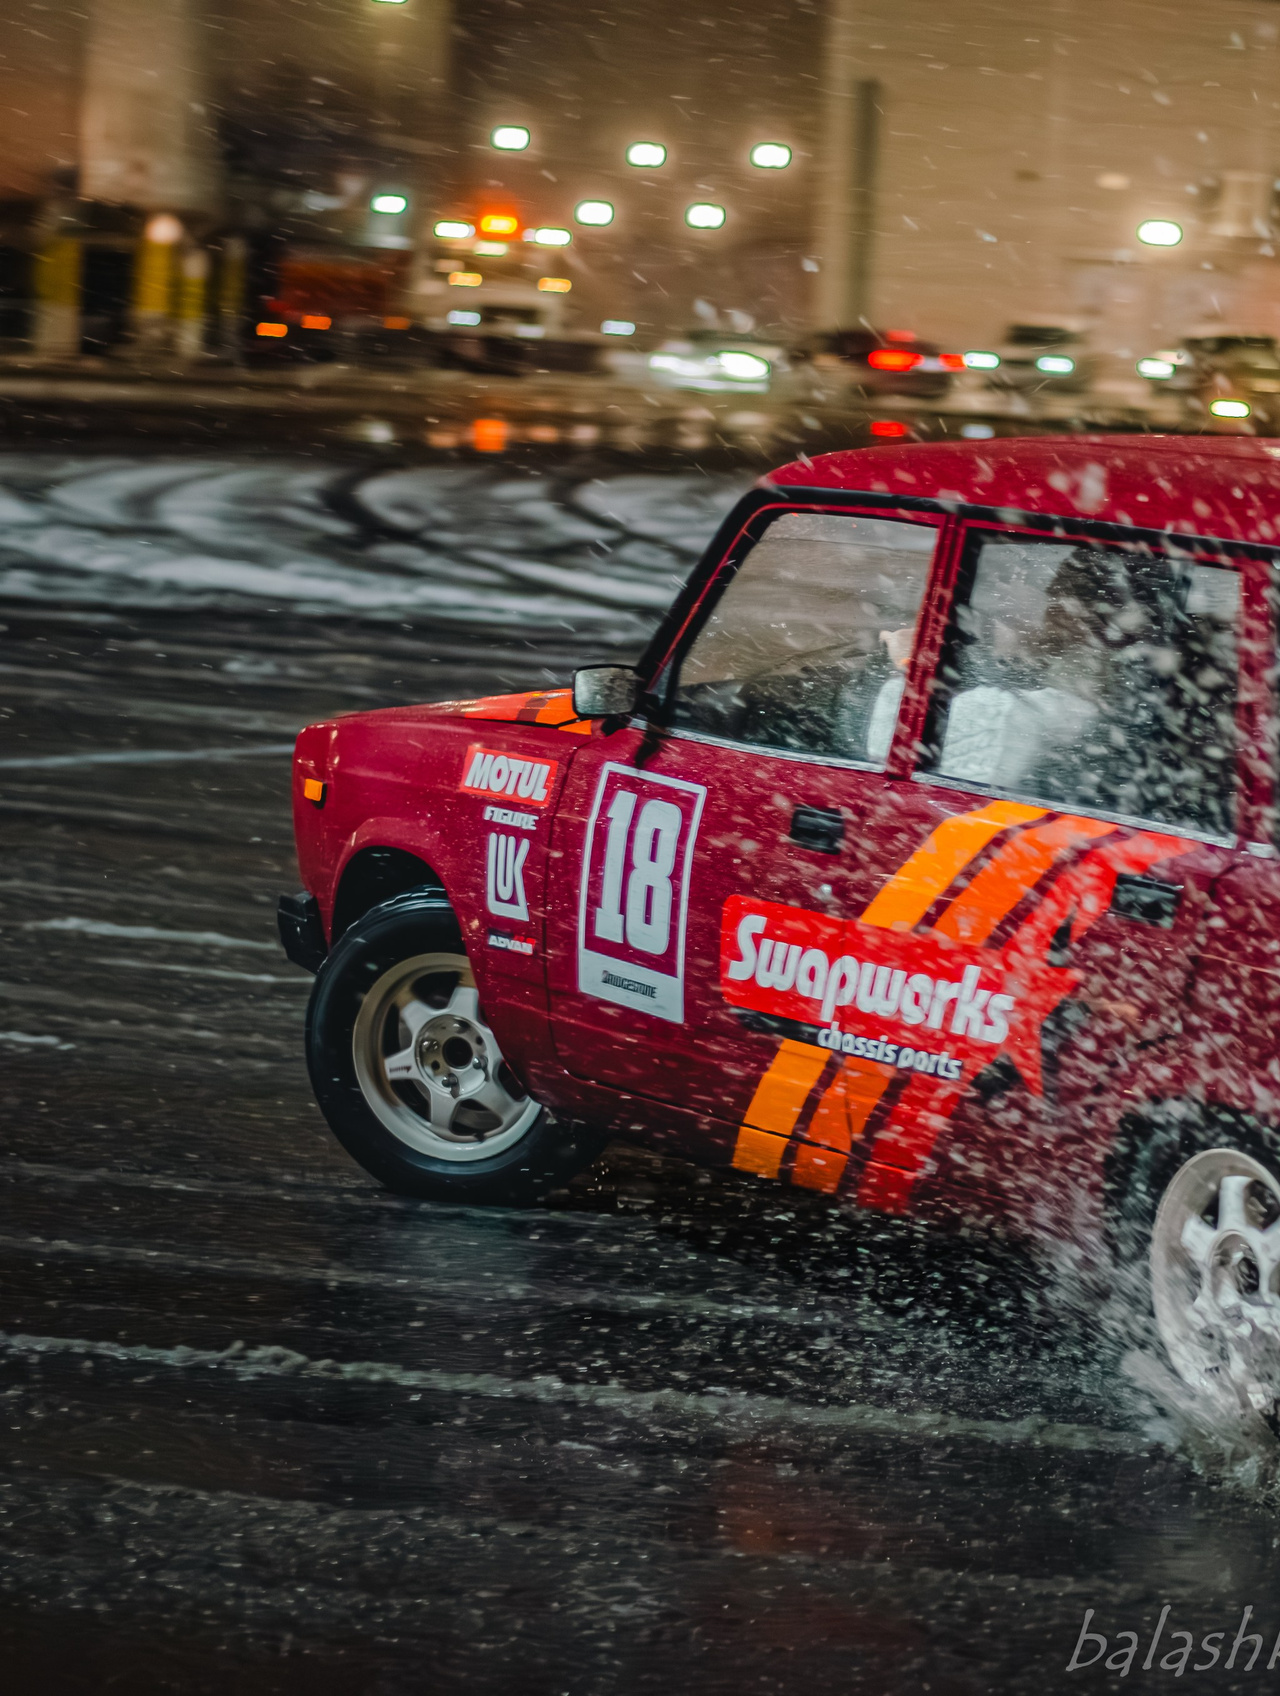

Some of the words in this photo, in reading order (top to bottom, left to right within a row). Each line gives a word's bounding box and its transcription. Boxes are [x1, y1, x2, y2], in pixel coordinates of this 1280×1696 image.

[465, 752, 551, 801] MOTUL
[594, 790, 683, 956] 18
[728, 914, 1015, 1044] Swapworks
[817, 1021, 898, 1065] chassis
[896, 1046, 964, 1080] parts
